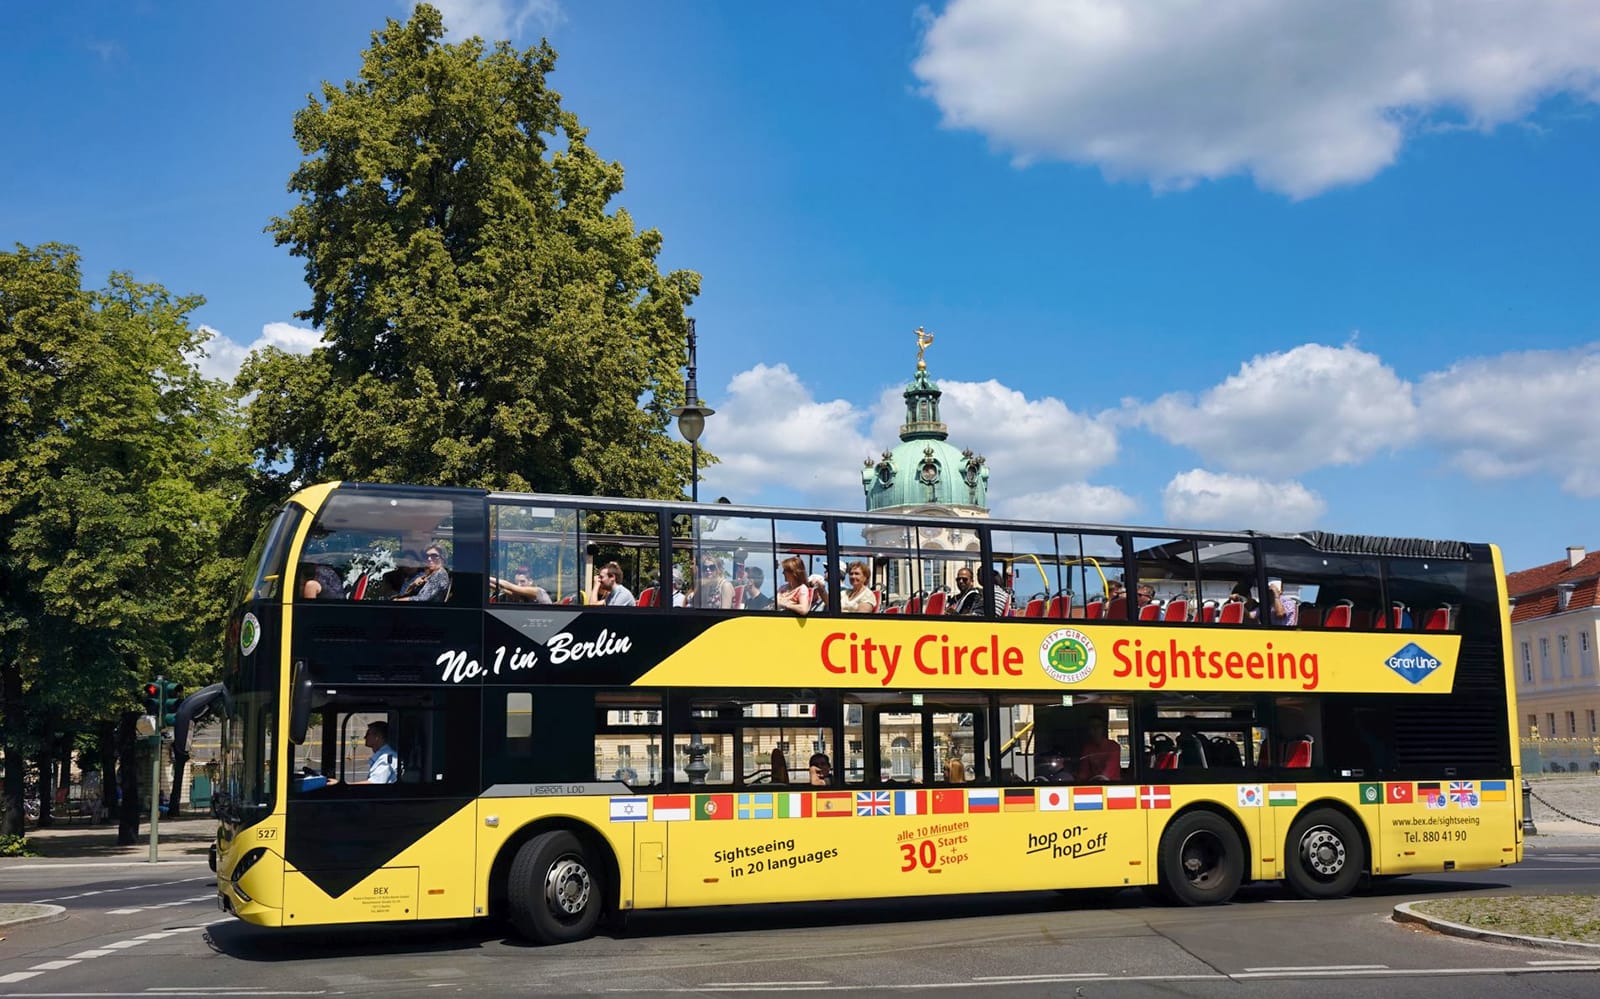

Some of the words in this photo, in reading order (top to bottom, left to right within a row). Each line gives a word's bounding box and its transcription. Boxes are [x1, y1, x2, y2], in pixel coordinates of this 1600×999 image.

[509, 647, 538, 671] in
[546, 628, 633, 665] Berlin
[821, 632, 902, 687] City
[913, 634, 1024, 676] Circle
[1112, 639, 1319, 690] Sightseeing
[1046, 665, 1092, 682] SIGHTSEEING
[897, 830, 914, 841] alle
[917, 827, 928, 837] 10
[930, 821, 969, 834] Minuten
[1392, 816, 1480, 827] www.bex.de/sightseeing
[258, 829, 276, 839] 527
[938, 835, 968, 848] Starts
[1028, 832, 1058, 849] hop
[1062, 826, 1088, 840] on-
[1404, 831, 1421, 843] Tel.
[1423, 831, 1440, 842] 880
[1441, 831, 1452, 842] 41
[1455, 830, 1467, 842] 90
[714, 839, 795, 863] Sightseeing
[1053, 842, 1082, 859] hop
[1087, 832, 1108, 850] off
[730, 866, 743, 878] in
[748, 861, 764, 875] 20
[768, 848, 838, 870] languages
[900, 840, 937, 873] 30
[940, 853, 969, 866] Stops
[373, 887, 389, 895] BEX
